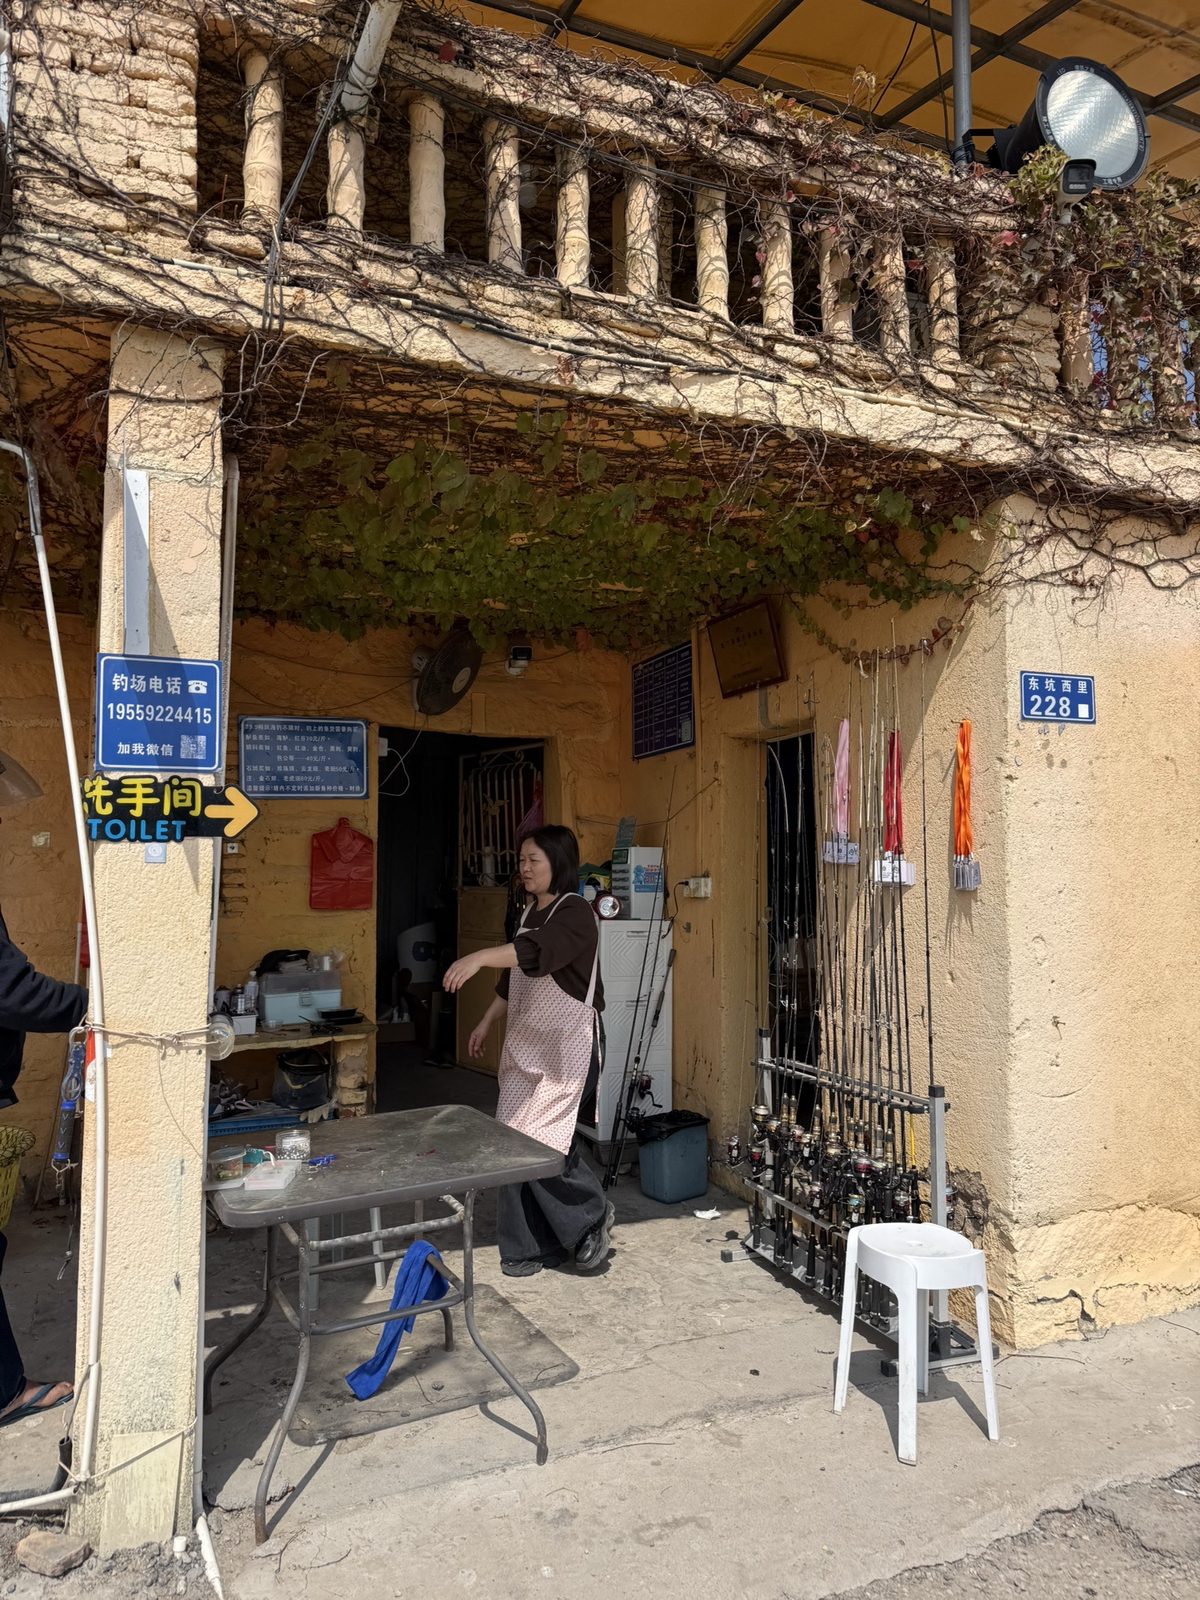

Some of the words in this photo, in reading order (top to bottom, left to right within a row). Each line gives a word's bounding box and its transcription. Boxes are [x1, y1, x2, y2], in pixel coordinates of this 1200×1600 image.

[112, 673, 182, 695] 钓场电话
[1028, 676, 1088, 694] 东坑西里
[107, 703, 212, 724] 19559224415
[1030, 695, 1071, 717] 228
[117, 742, 174, 756] 加我微信
[83, 775, 202, 817] 洗手间
[88, 819, 186, 841] TOILET
